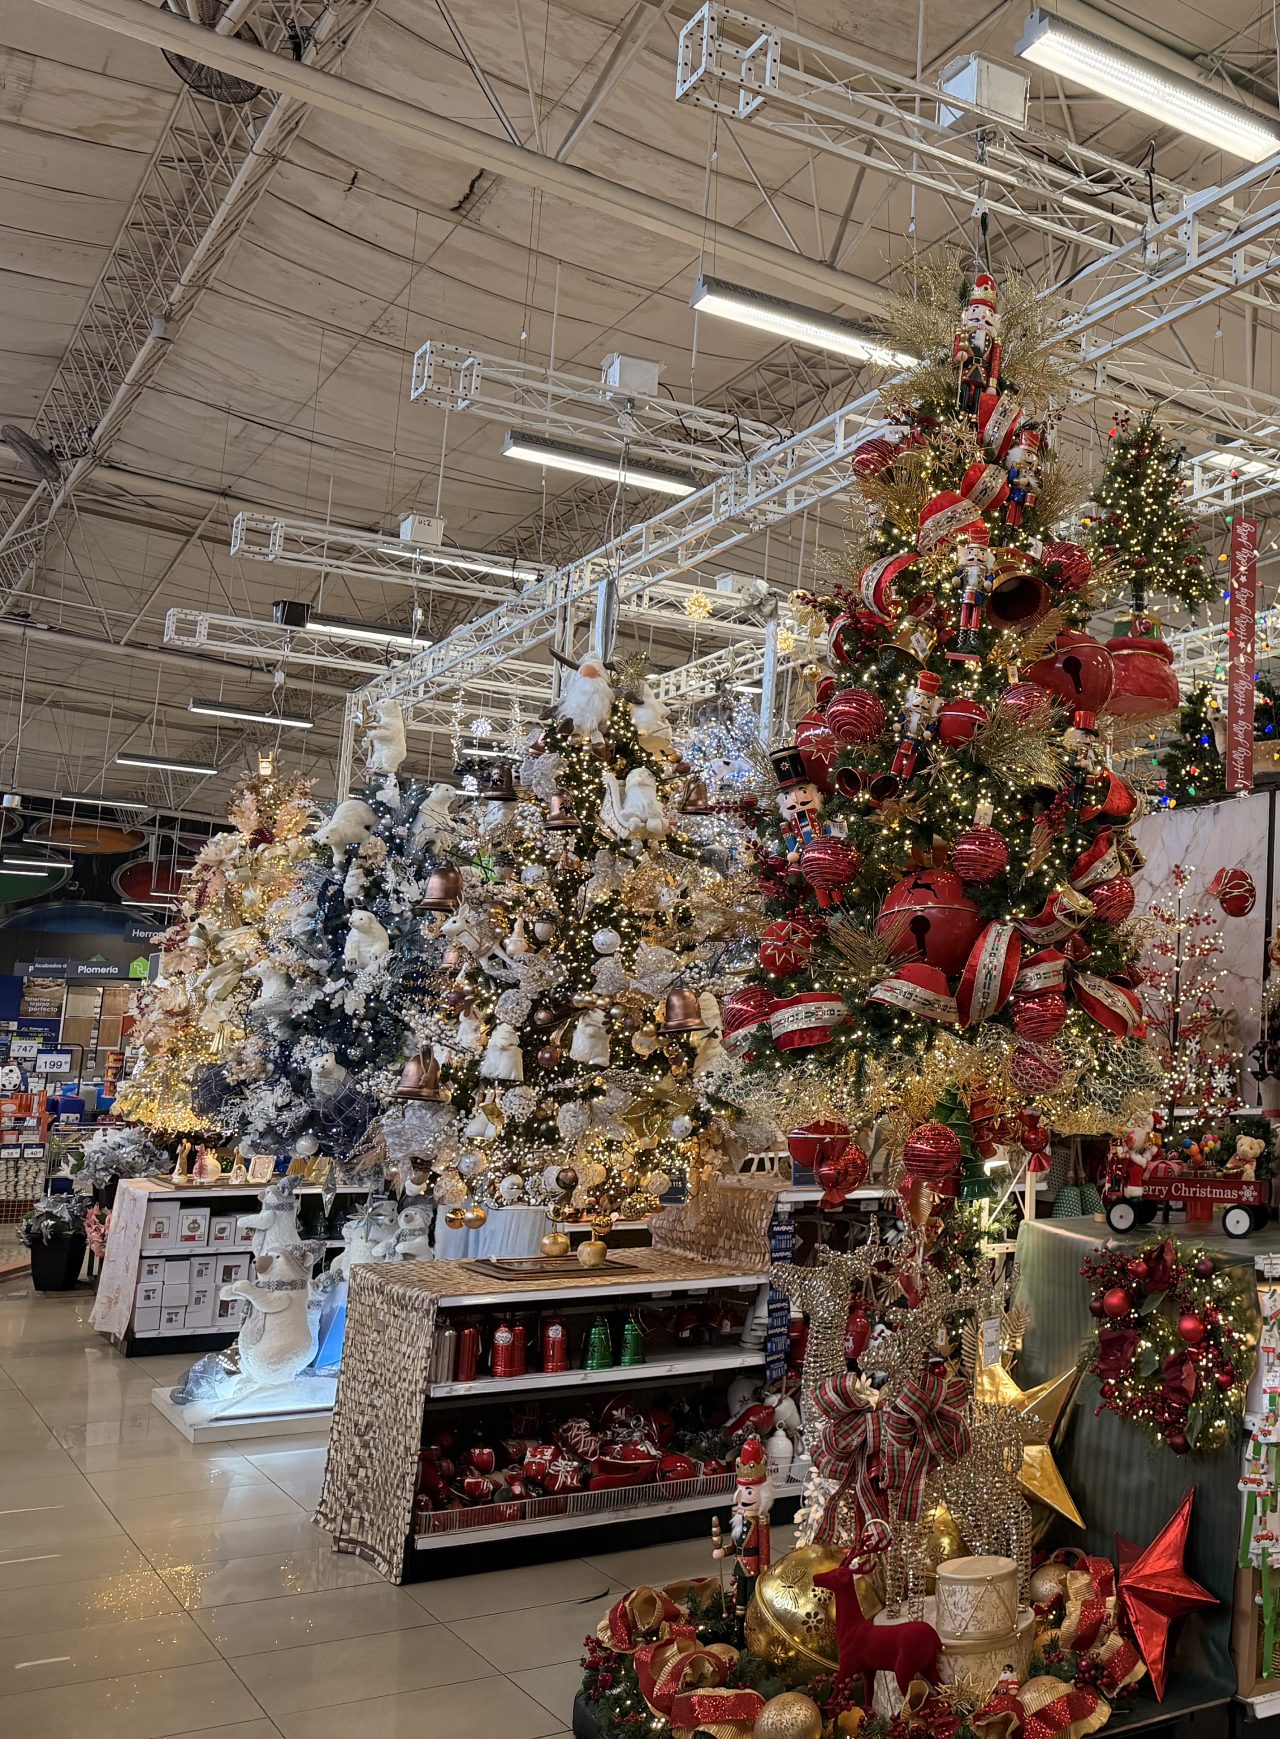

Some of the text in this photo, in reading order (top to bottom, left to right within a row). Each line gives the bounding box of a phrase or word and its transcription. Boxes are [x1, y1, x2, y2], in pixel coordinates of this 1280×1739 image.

[1236, 522, 1255, 549] Jolly
[1235, 587, 1254, 615] Jolly
[1235, 613, 1253, 640] Holly
[1233, 680, 1252, 706] Holly
[1232, 747, 1251, 777] Holly
[77, 965, 119, 974] Plomería
[17, 1045, 33, 1054] 747
[43, 1060, 63, 1070] 199
[1142, 1182, 1238, 1199] erry Christmas
